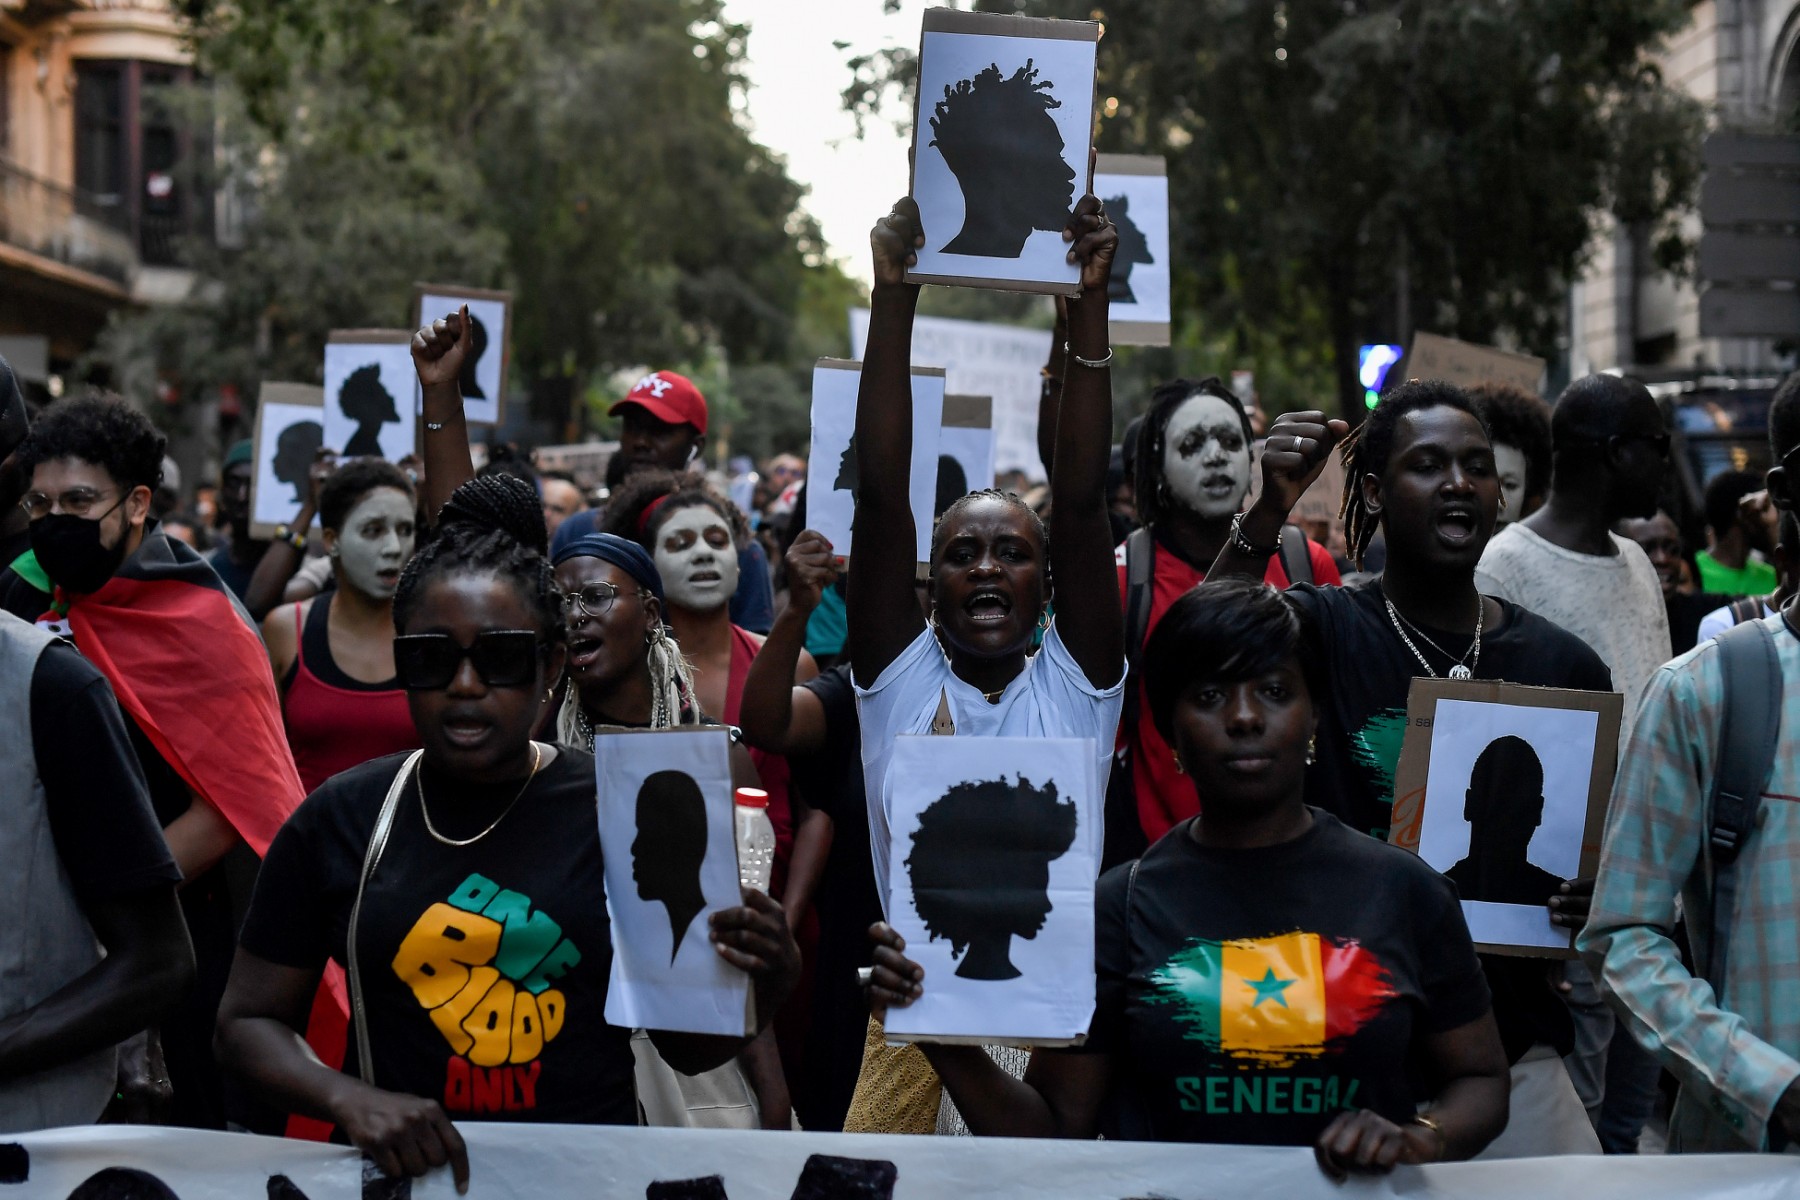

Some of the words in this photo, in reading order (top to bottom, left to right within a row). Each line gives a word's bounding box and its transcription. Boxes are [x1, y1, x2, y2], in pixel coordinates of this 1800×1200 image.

[633, 373, 673, 398] NY
[447, 872, 582, 995] ONE
[391, 902, 566, 1067] BLOOD
[444, 1055, 541, 1112] ONLY
[1175, 1075, 1360, 1114] SENEGAL
